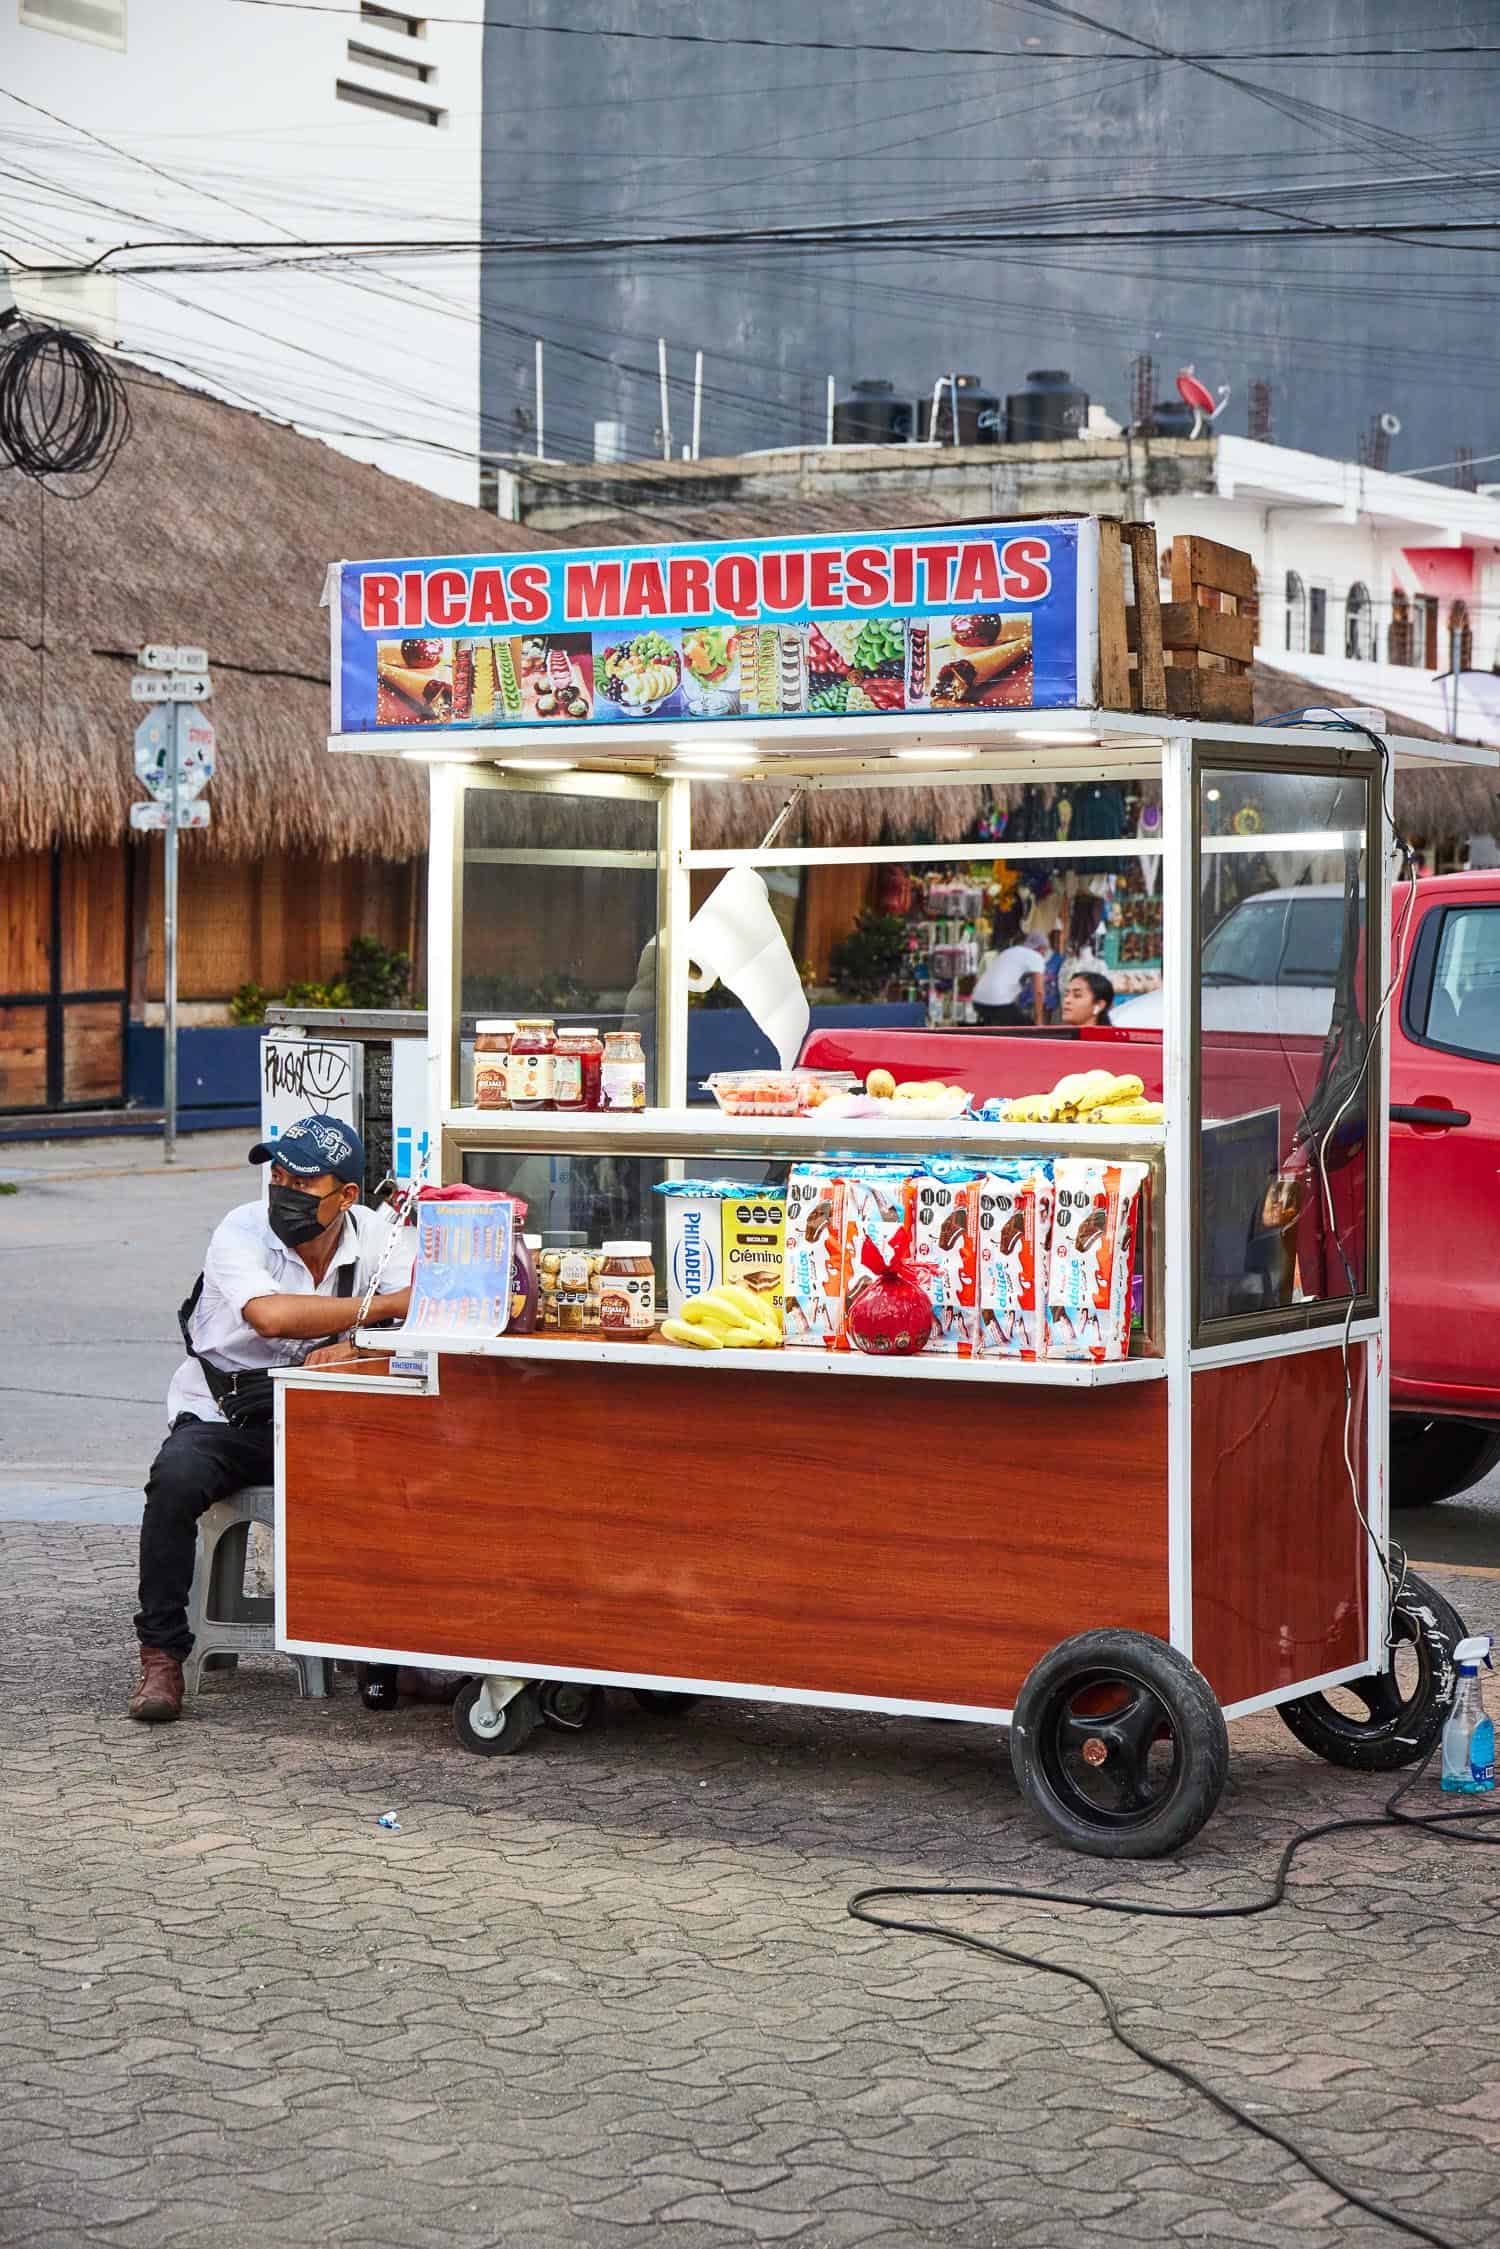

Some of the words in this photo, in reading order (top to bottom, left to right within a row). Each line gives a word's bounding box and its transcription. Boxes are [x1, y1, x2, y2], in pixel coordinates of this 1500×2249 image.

[361, 565, 549, 629] RICAS
[565, 539, 1051, 619] MARQUESITAS
[276, 1151, 289, 1163] SAN
[683, 1211, 702, 1298] PHILADELP
[729, 1248, 783, 1264] Crémino
